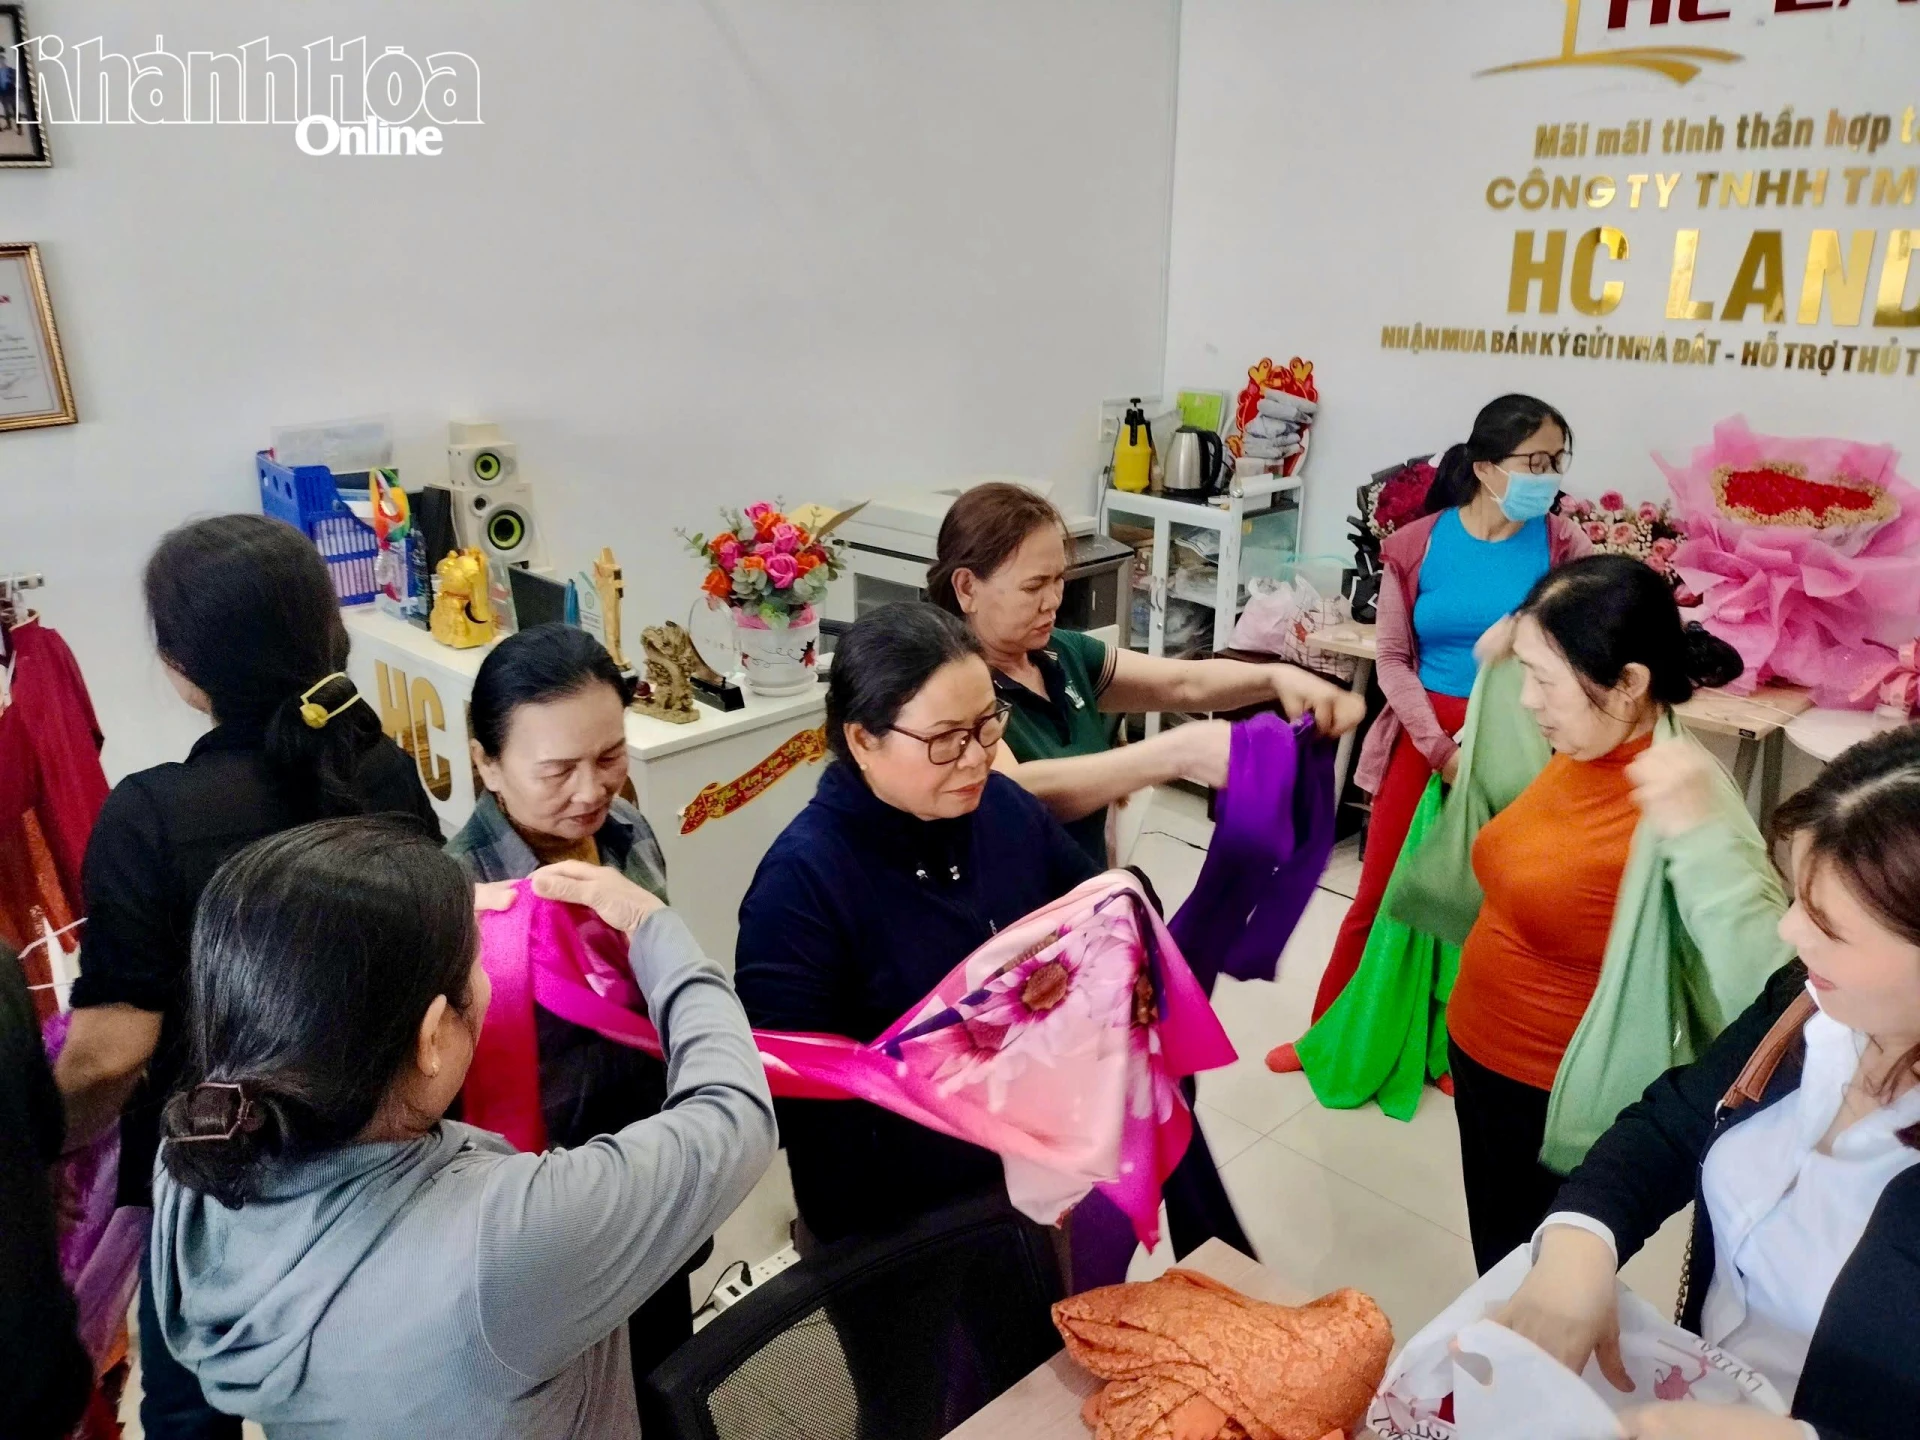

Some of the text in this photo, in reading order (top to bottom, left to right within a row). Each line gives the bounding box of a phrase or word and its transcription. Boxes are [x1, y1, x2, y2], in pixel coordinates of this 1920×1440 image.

[1533, 121, 1589, 158] Mãi
[1595, 117, 1652, 156] mãi
[1736, 103, 1814, 149] thần
[1825, 107, 1891, 154] hợp
[1485, 166, 1618, 212] CÔNG
[1626, 172, 1682, 209] TY
[1696, 168, 1830, 209] TNHH
[1507, 225, 1920, 328] HC LAND
[1741, 330, 1780, 368] HỖ
[1783, 339, 1839, 376] TRỢ
[1842, 336, 1901, 376] THỦ
[374, 658, 453, 802] HC
